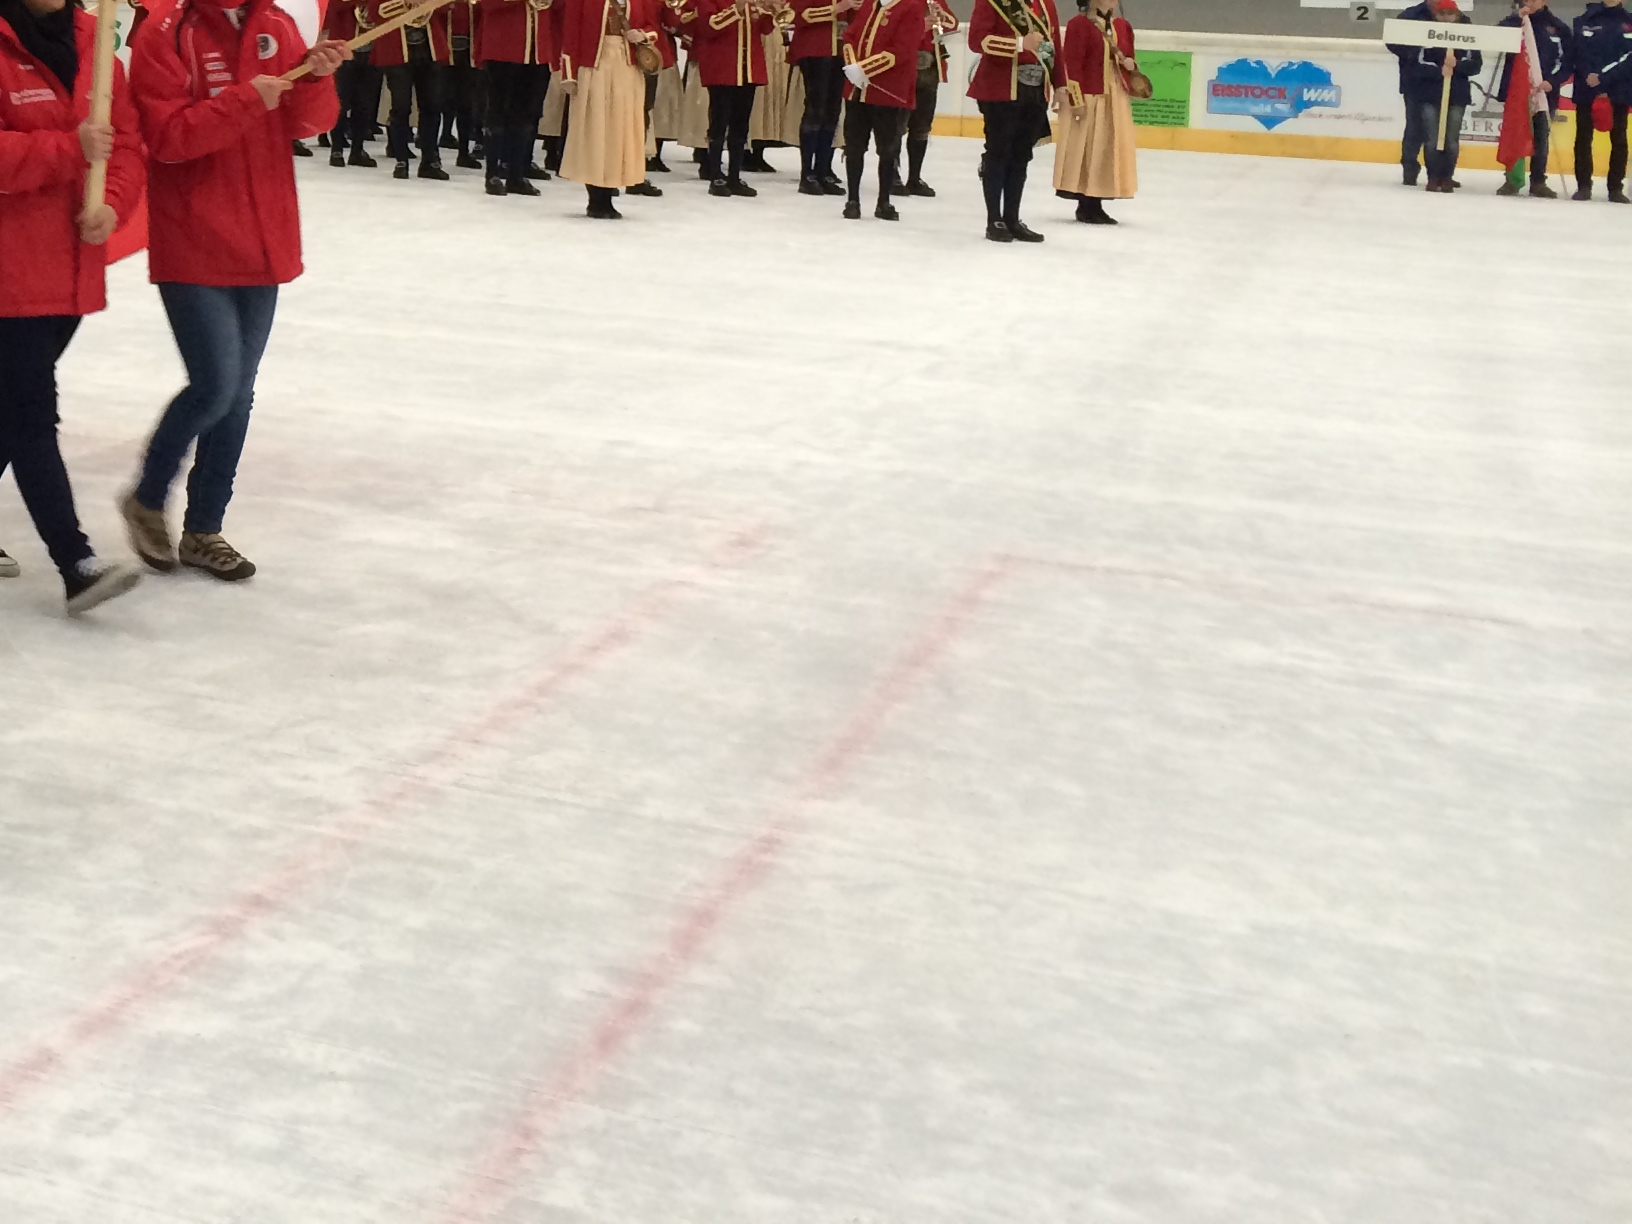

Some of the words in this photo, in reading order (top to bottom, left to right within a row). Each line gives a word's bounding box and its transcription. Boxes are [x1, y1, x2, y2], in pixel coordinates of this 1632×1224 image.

[1356, 5, 1370, 21] 2
[1427, 29, 1476, 44] Belarus
[1211, 84, 1288, 100] EISSTOCK
[1302, 87, 1337, 103] WM
